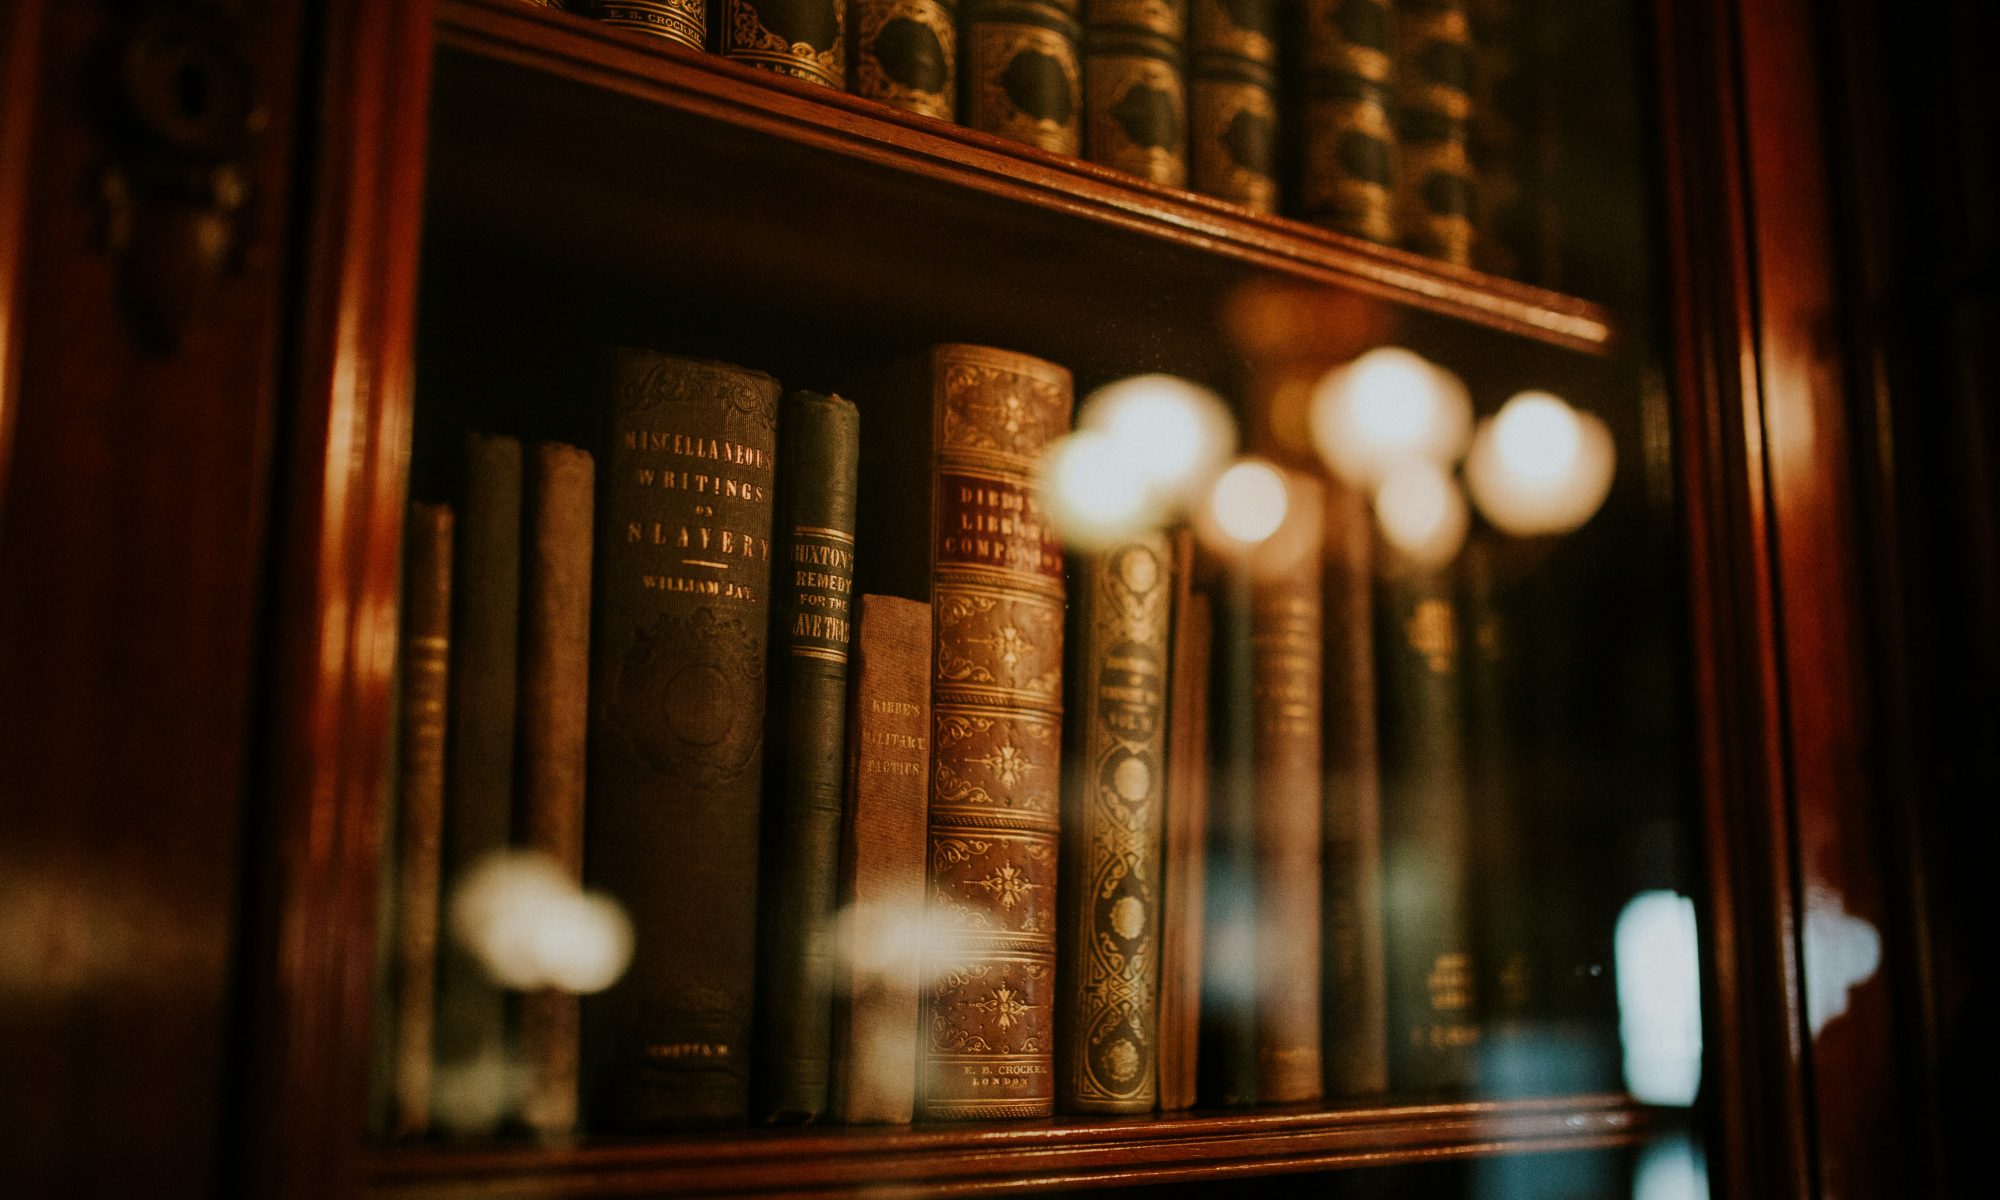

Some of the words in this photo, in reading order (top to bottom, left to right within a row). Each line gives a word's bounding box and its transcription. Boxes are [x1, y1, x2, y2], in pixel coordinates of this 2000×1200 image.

[625, 431, 771, 472] MISCELLANEOUS
[639, 468, 763, 502] WRITINGS
[628, 521, 769, 562] SLAVERY
[642, 575, 720, 595] WILLIAM
[796, 570, 852, 594] REMEDY
[800, 593, 826, 608] FOR
[829, 597, 848, 612] THE
[972, 1078, 1029, 1087] LONDON
